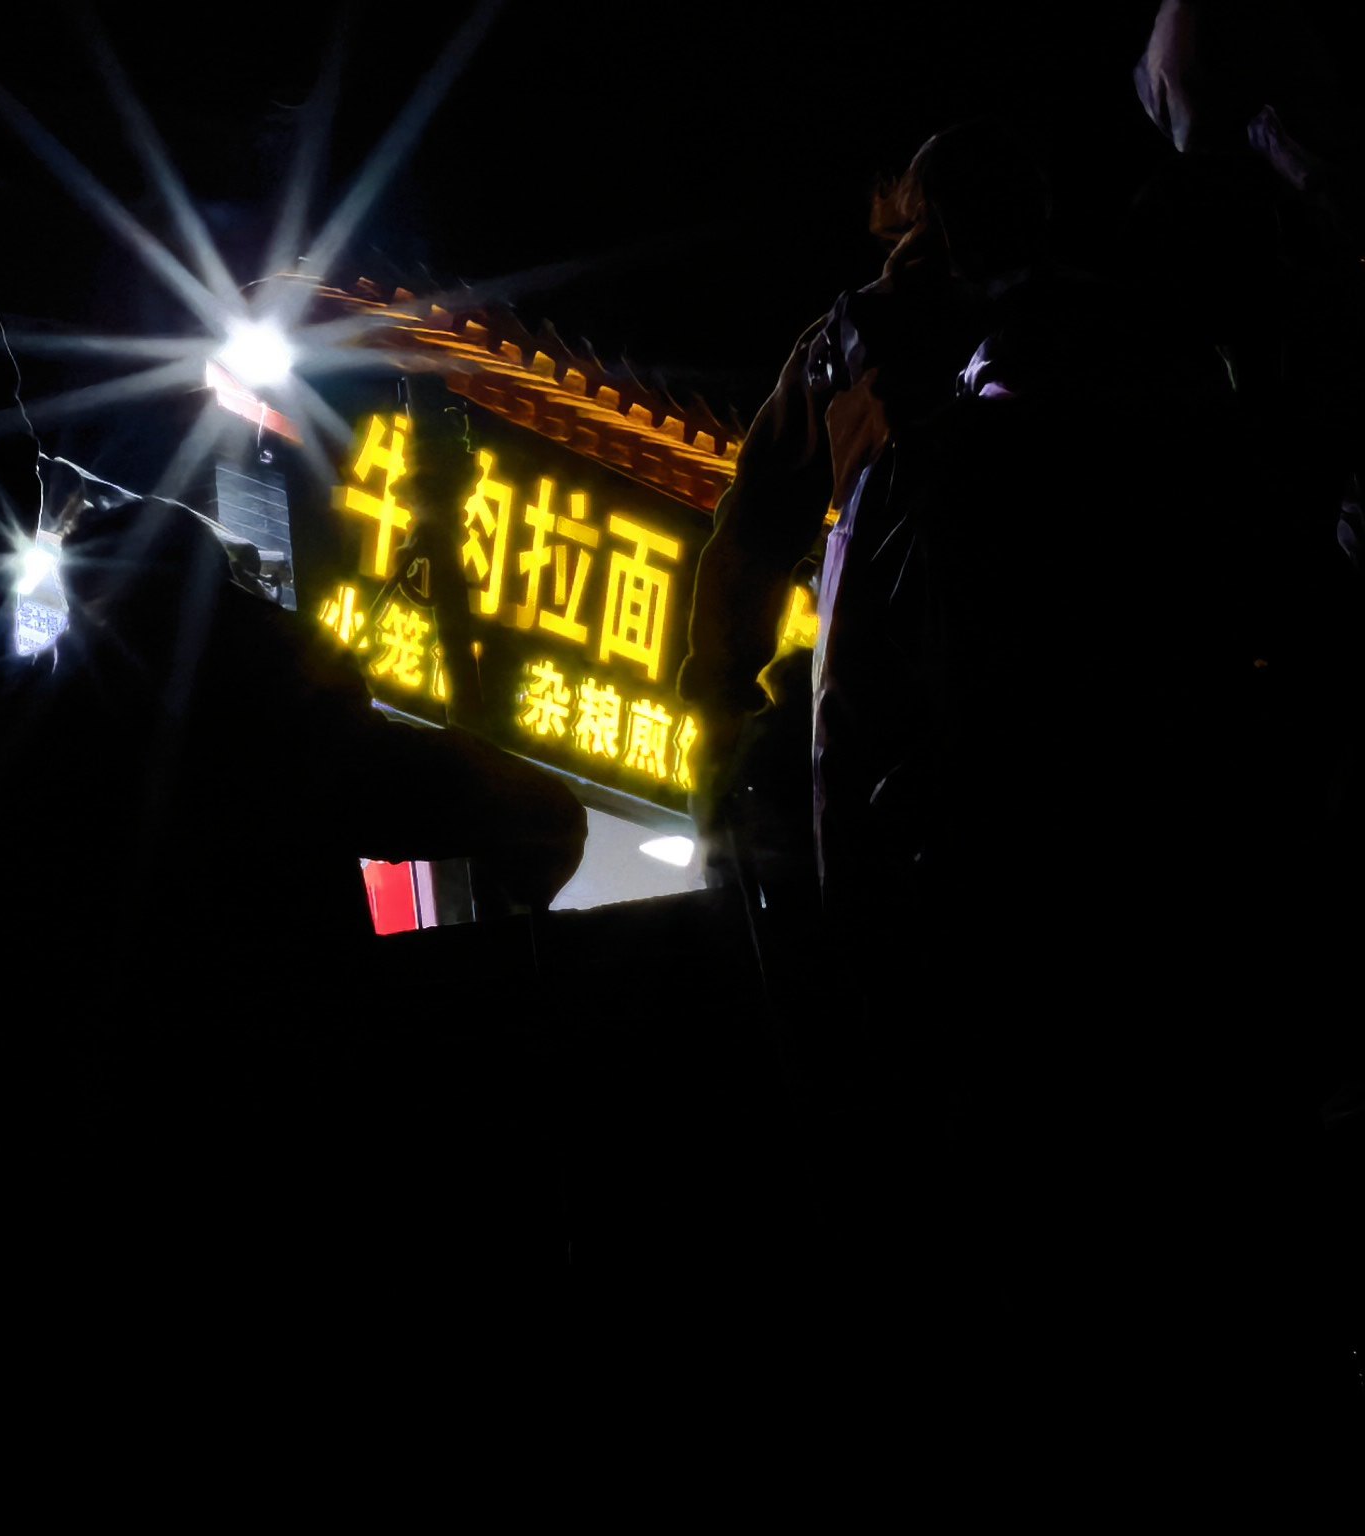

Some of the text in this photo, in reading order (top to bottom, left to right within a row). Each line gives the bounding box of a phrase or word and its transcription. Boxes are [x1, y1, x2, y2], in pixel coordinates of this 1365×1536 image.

[319, 585, 447, 698] 小笼
[345, 414, 680, 680] 牛肉拉面
